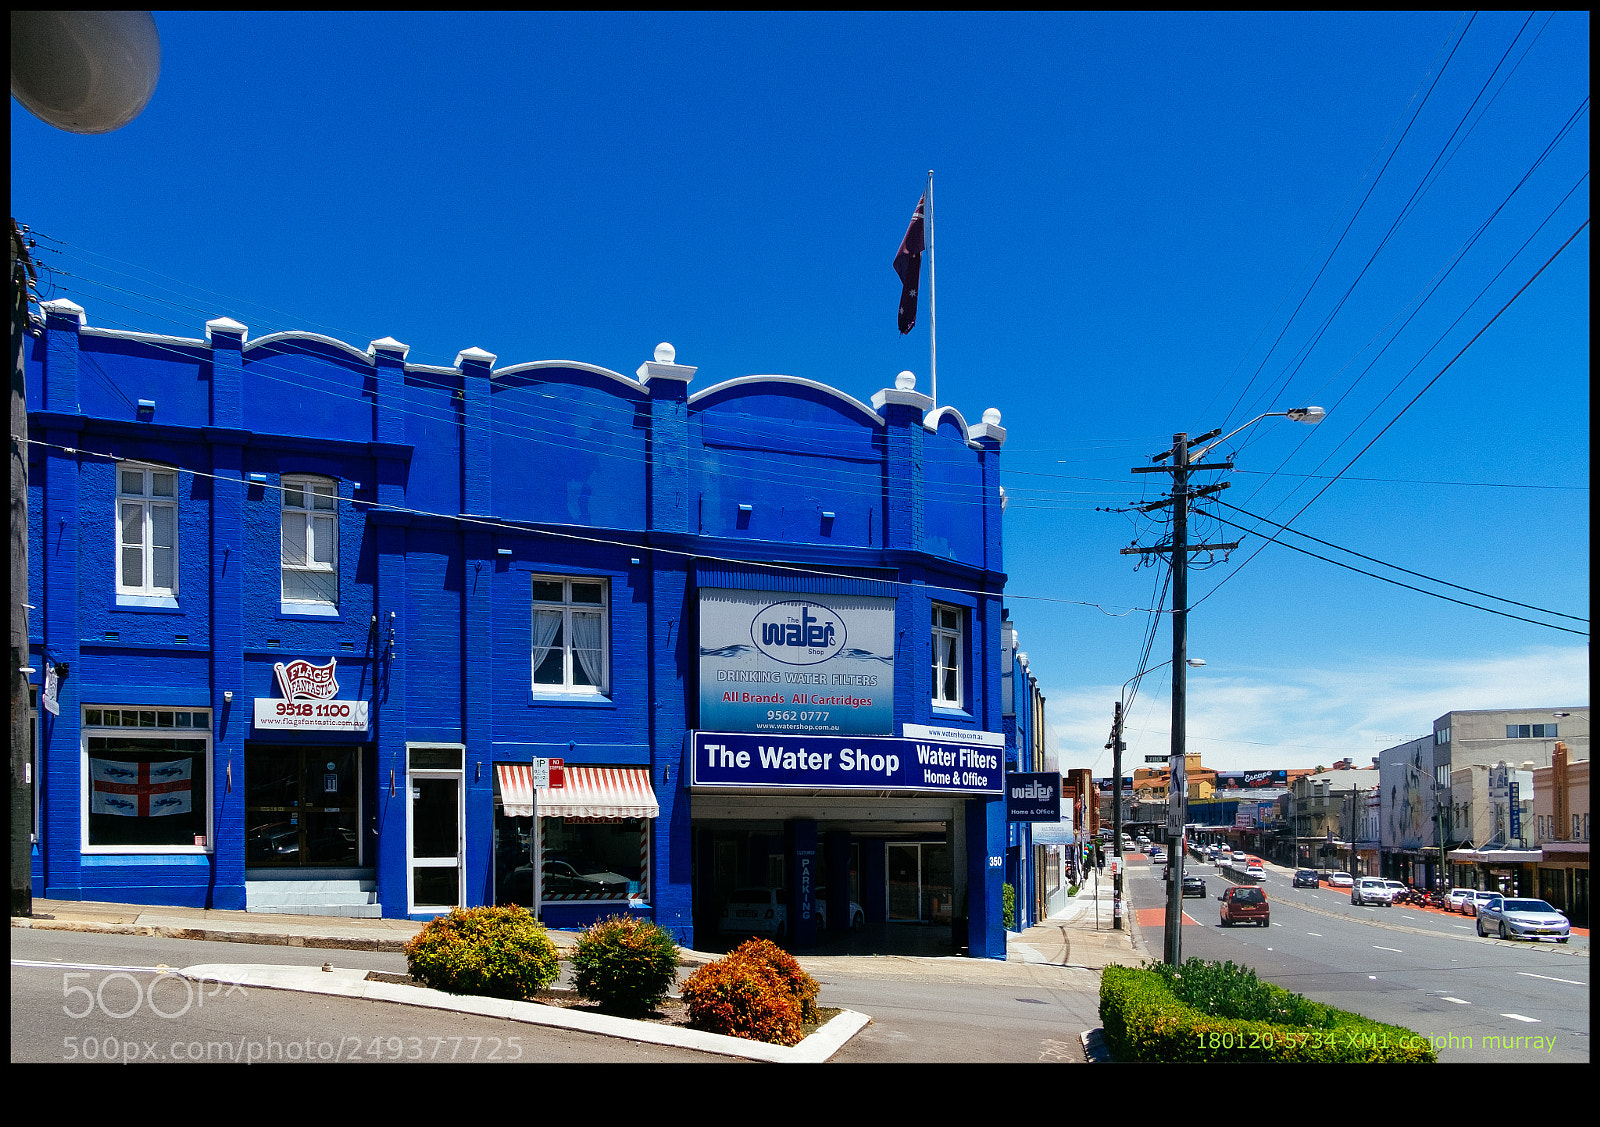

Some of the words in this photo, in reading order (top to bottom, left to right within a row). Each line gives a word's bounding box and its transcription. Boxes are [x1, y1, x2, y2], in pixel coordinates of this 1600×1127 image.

[787, 616, 800, 624] The
[808, 648, 825, 656] Shop
[290, 664, 331, 681] FLAGS
[716, 669, 781, 684] DRINKING
[785, 671, 828, 686] WATER
[831, 673, 878, 688] FILTERS
[291, 679, 333, 697] FANTASTIC
[722, 691, 739, 703] All
[742, 692, 785, 704] Brands
[791, 693, 808, 705] All
[811, 694, 873, 708] Cartridges
[276, 702, 314, 717] 9518
[315, 704, 351, 718] 1100
[767, 709, 798, 721] 9562
[799, 710, 830, 722] 0777
[260, 717, 365, 728] www.flagsfantastic.com.au
[756, 721, 840, 732] www.watershop.com.au
[928, 729, 984, 742] www.watershop.com.au
[704, 744, 751, 769] The
[758, 745, 833, 771] Water
[839, 747, 900, 777] Shop
[915, 744, 957, 768] Water
[959, 748, 998, 770] Filters
[923, 768, 951, 785] Home
[952, 770, 961, 786] &
[962, 771, 988, 787] Office
[1244, 770, 1273, 783] Escape
[989, 855, 1003, 867] 350
[801, 859, 811, 920] PARKING
